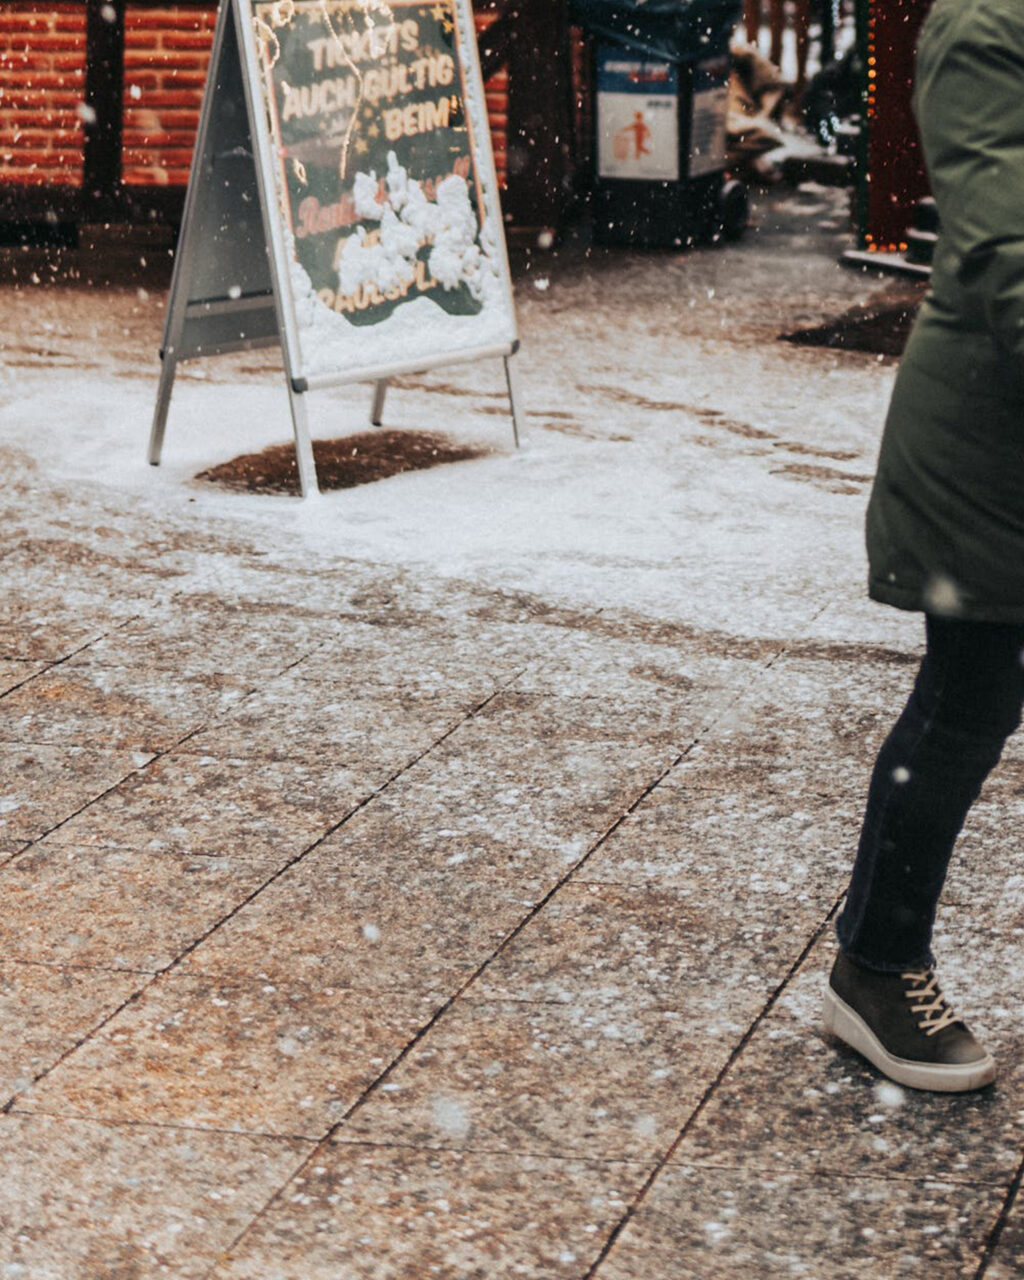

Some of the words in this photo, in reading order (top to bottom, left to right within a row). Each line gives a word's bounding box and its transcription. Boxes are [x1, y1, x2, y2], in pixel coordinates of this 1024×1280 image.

[306, 18, 420, 71] TICKETS
[282, 76, 357, 123] AUCH
[381, 96, 451, 142] BEIM
